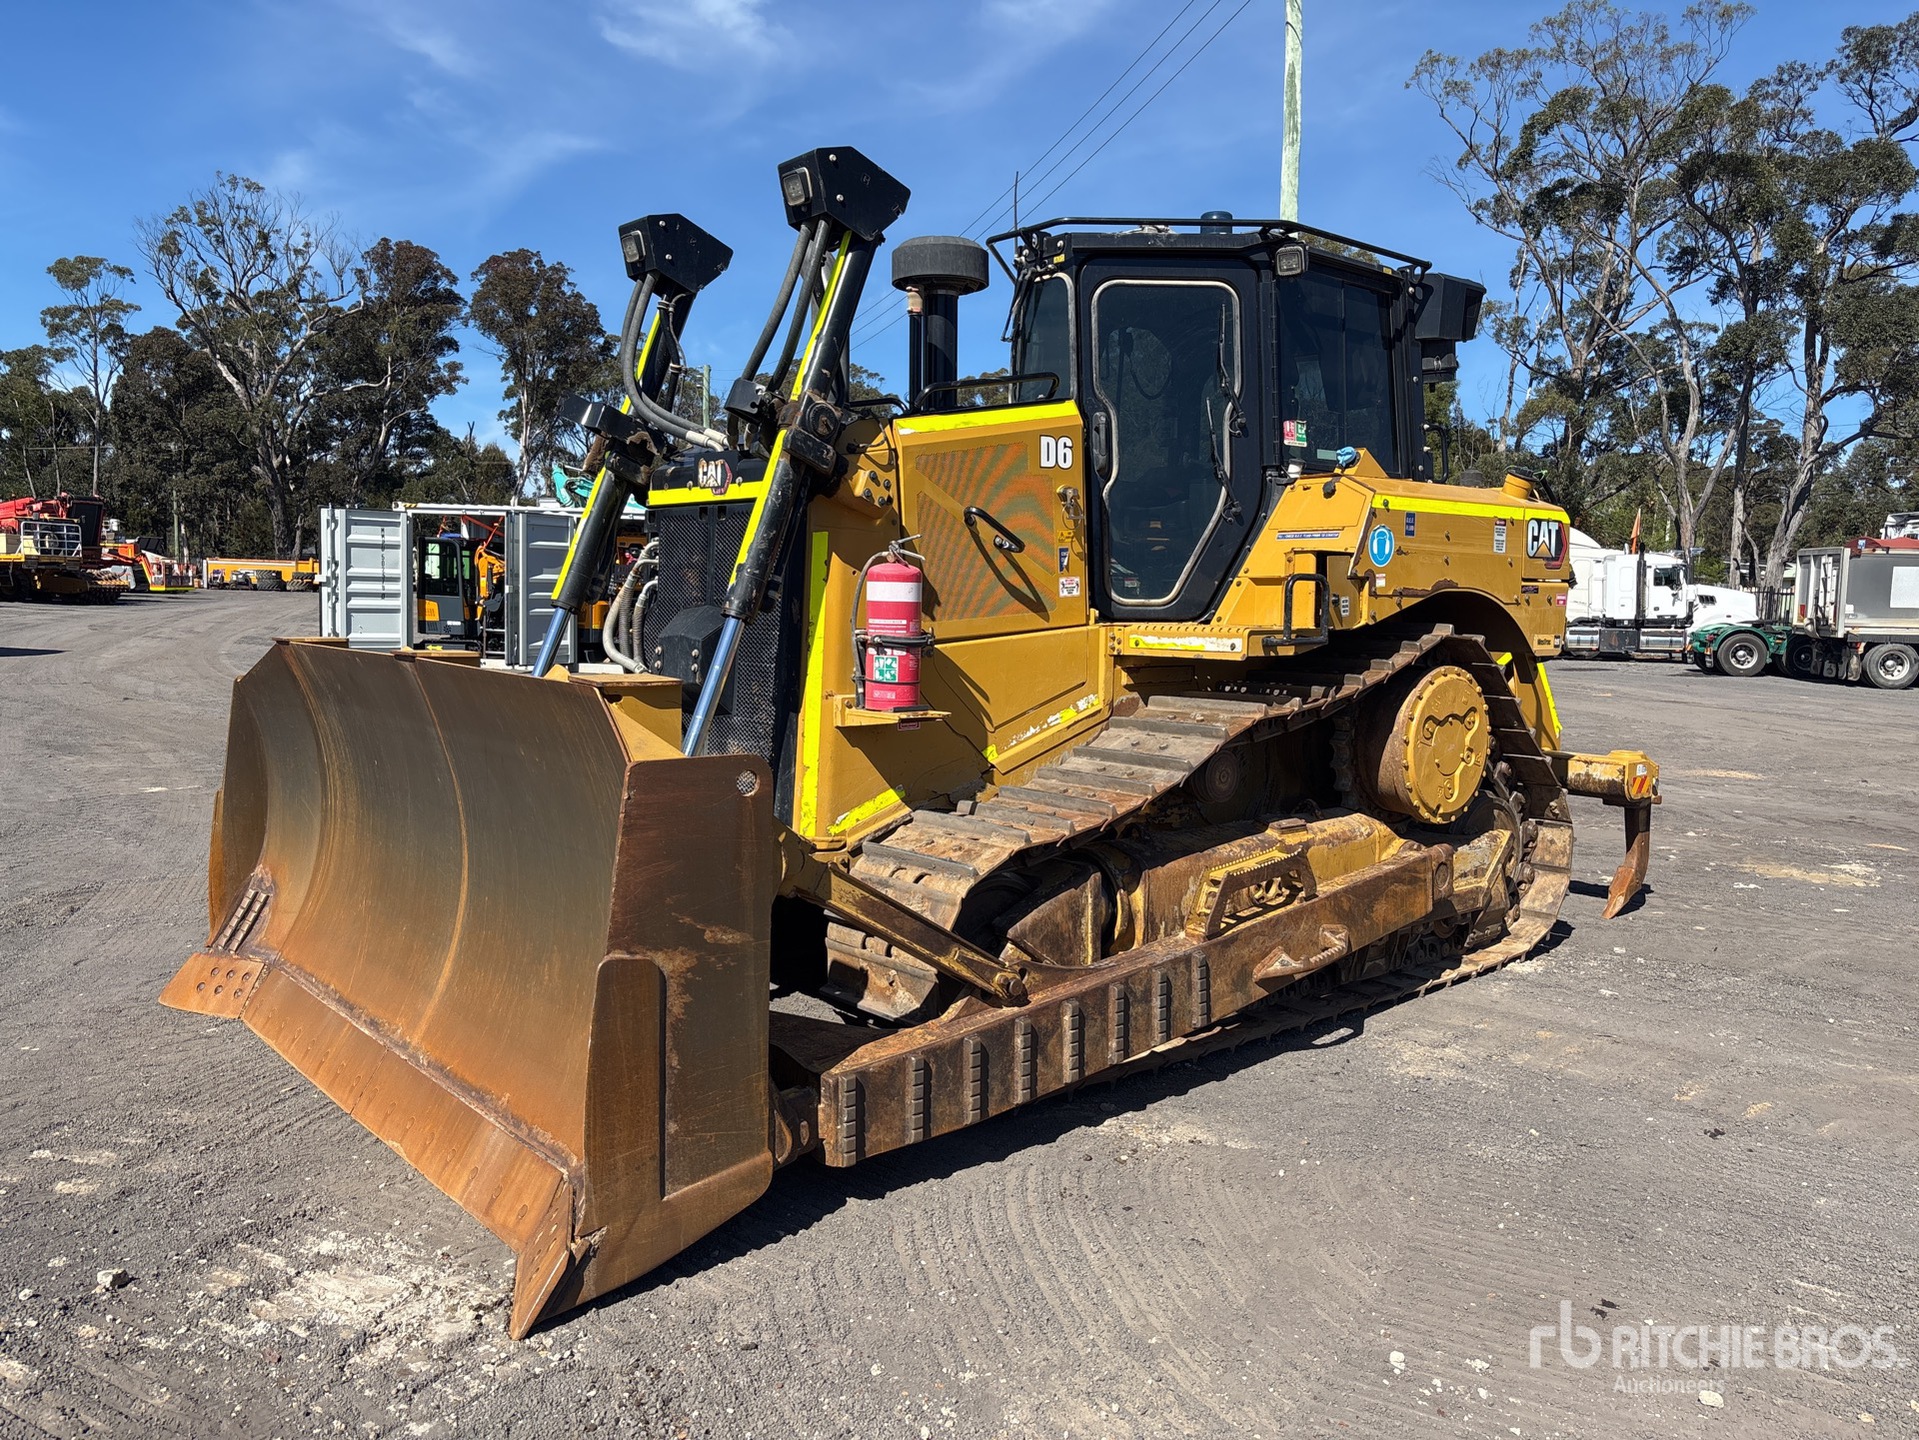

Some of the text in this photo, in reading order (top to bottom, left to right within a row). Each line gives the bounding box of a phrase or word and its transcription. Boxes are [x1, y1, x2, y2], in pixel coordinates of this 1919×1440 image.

[1039, 434, 1073, 470] D6
[698, 458, 725, 488] CAT
[1527, 519, 1559, 558] CAT
